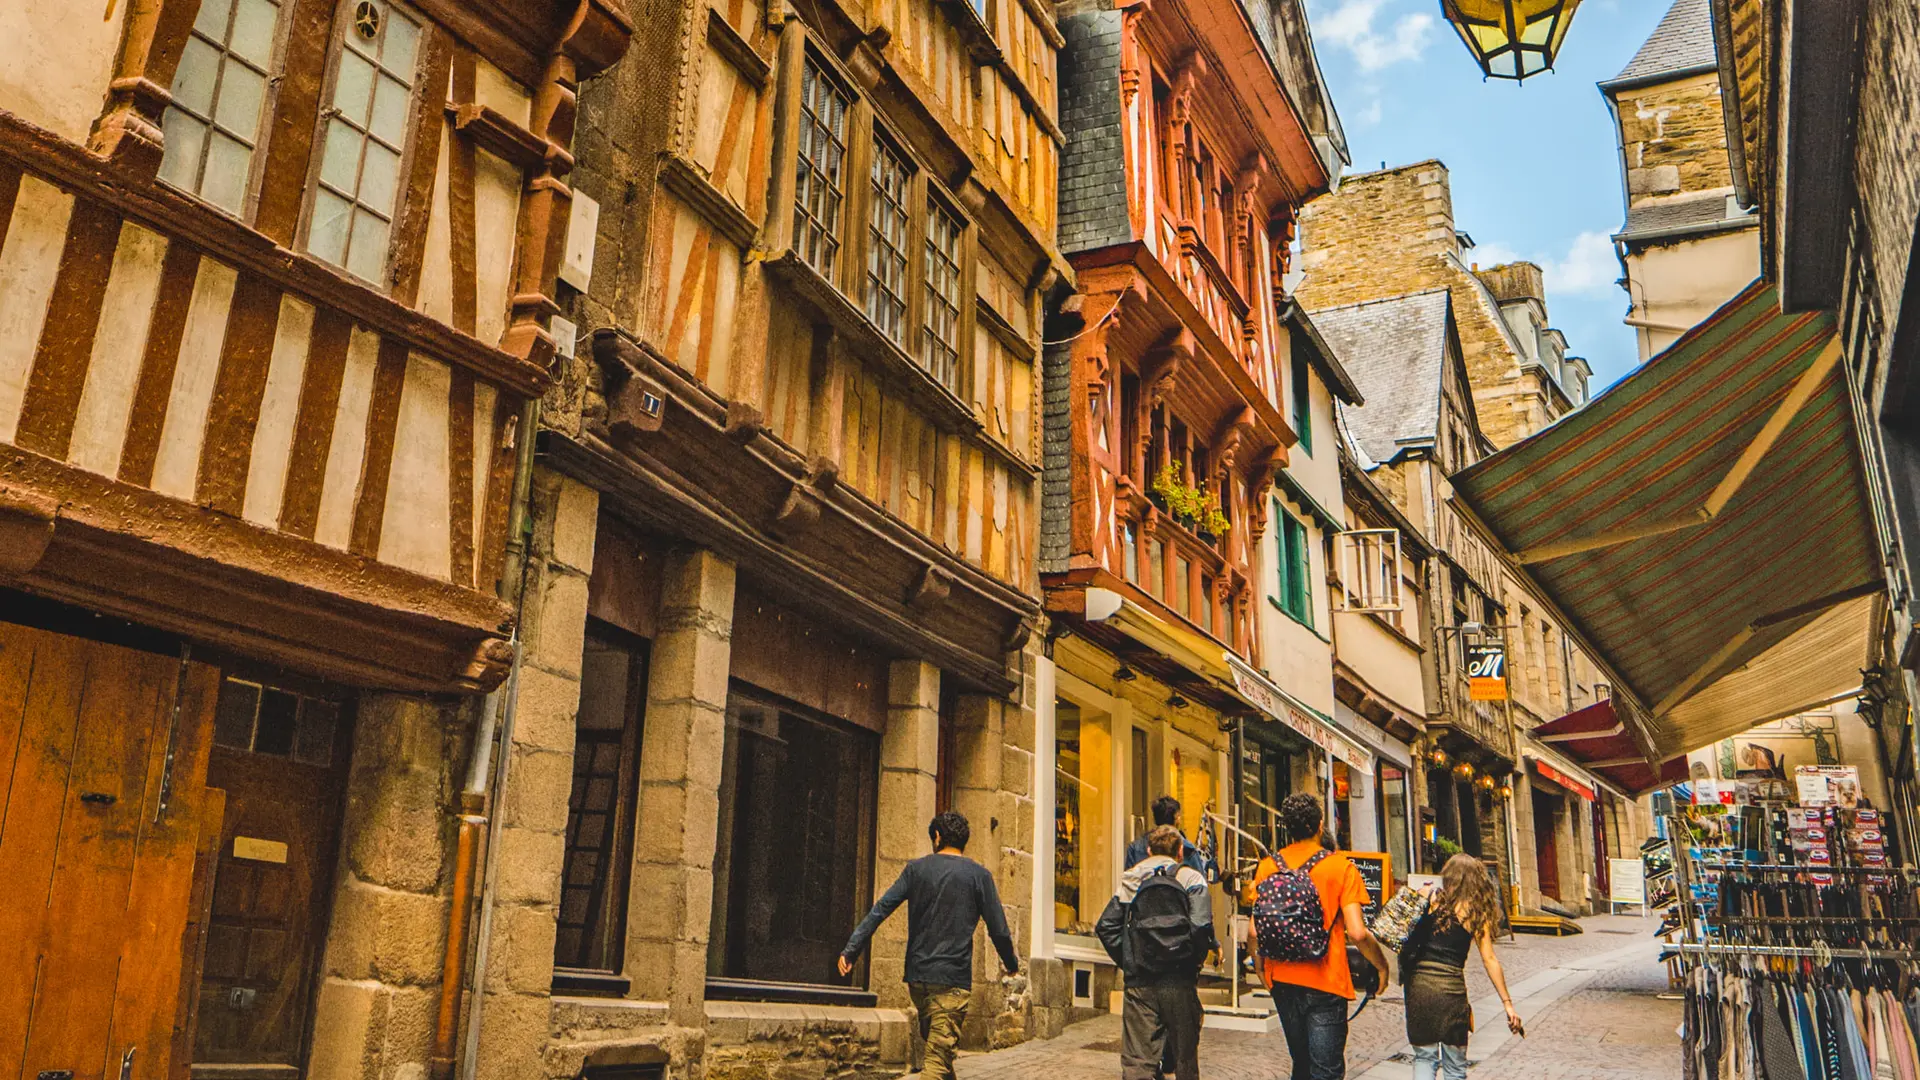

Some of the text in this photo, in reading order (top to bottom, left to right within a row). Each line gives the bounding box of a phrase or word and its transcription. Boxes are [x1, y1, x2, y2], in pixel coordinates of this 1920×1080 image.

[647, 397, 655, 412] 1
[1469, 654, 1504, 681] M
[1289, 709, 1311, 737] CROCO
